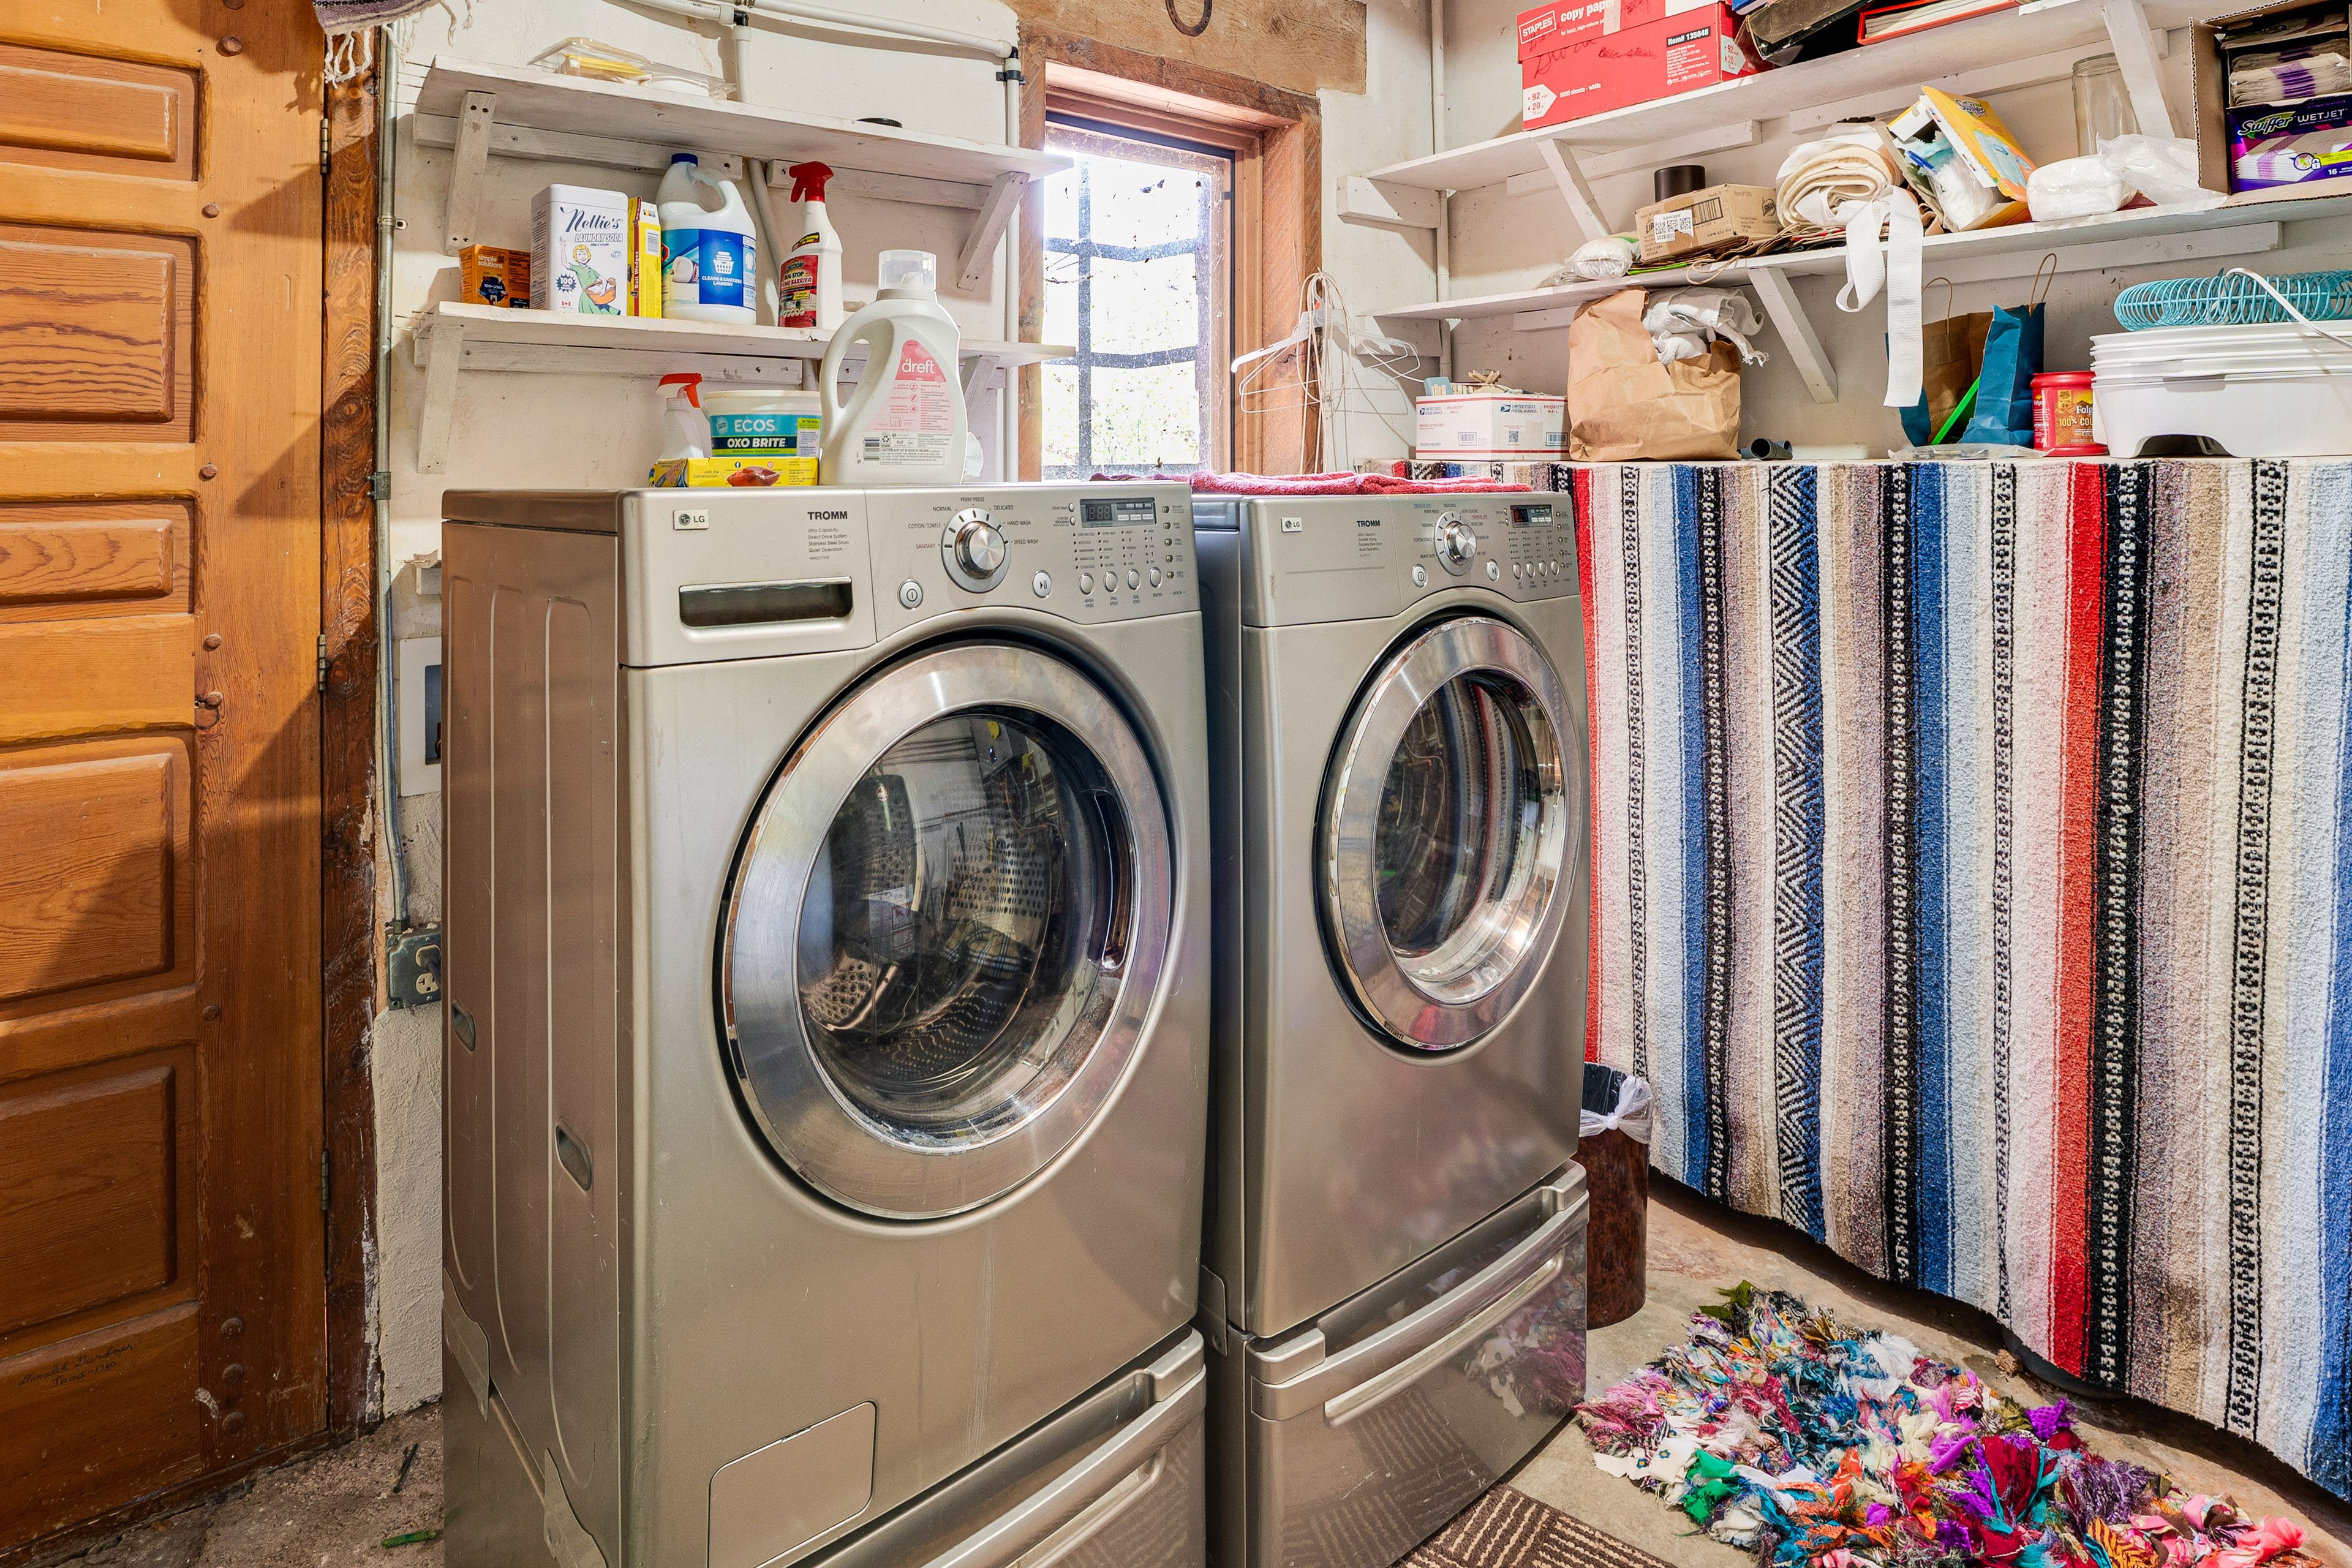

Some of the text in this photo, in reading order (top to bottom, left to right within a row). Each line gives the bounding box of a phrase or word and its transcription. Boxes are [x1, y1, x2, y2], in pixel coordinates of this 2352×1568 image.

[1560, 6, 1585, 22] copy
[1522, 16, 1553, 37] STAPLES
[1667, 28, 1709, 46] Item# 135848
[1570, 87, 1586, 96] sheets
[1588, 82, 1601, 91] white
[1532, 92, 1541, 101] 92
[1532, 102, 1541, 110] 20
[1955, 99, 1987, 118] Swiffer
[2237, 108, 2345, 136] Swiffer WETJET
[560, 206, 622, 233] Nellie's
[575, 233, 624, 243] LAUNDRY SODA
[478, 254, 503, 269] simple solutions
[791, 277, 812, 285] BARRIER
[902, 358, 935, 374] dreft
[2076, 405, 2094, 415] Folg
[734, 418, 775, 432] ECOS
[2059, 417, 2078, 428] 100%
[726, 437, 786, 448] OXO BRITE
[807, 511, 848, 521] TROMM
